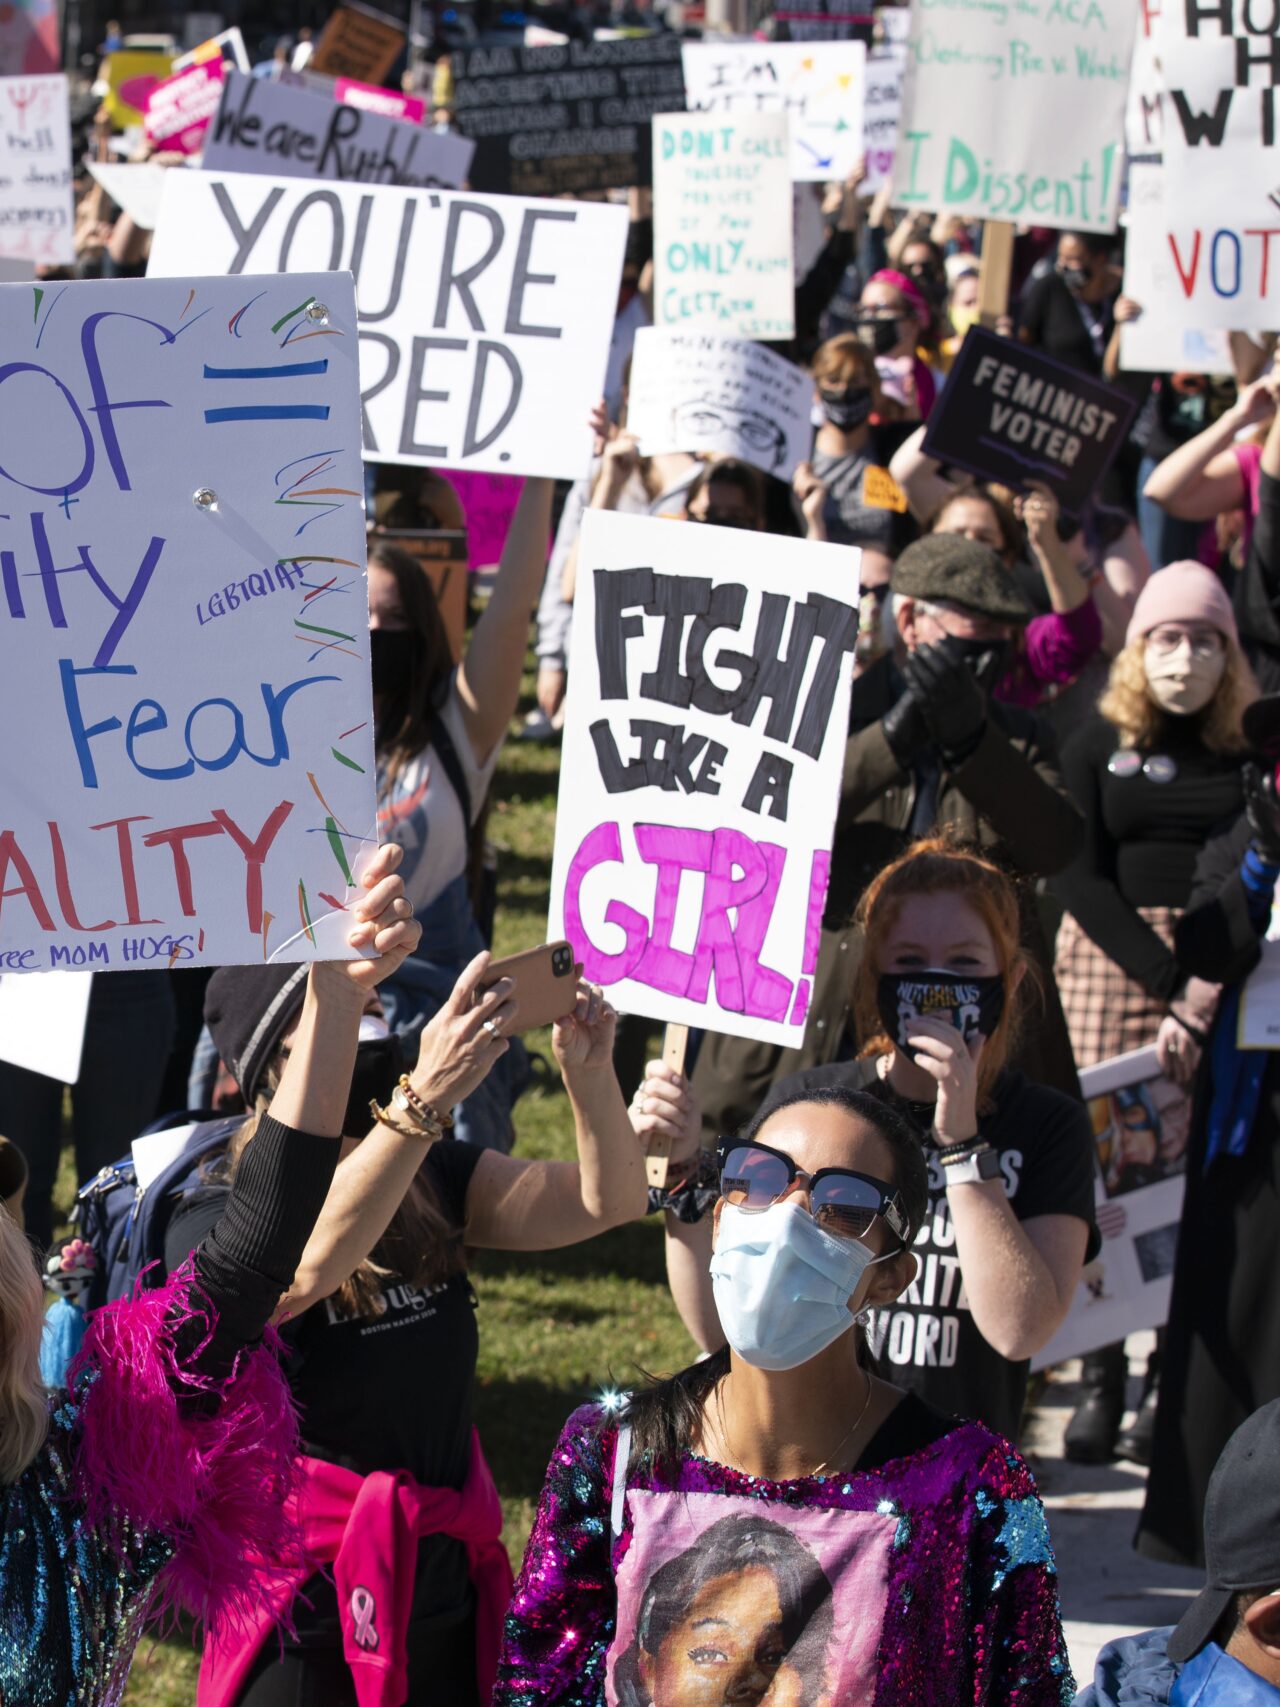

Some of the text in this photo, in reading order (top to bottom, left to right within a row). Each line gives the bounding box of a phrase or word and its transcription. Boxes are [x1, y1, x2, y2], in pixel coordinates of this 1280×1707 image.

[898, 131, 1117, 224] I Dissent!
[210, 183, 577, 338] YOU'RE
[667, 239, 745, 275] ONLY
[973, 354, 1117, 442] FEMINIST
[989, 400, 1082, 468] VOTER
[593, 567, 860, 761] FIGHT
[58, 658, 342, 789] Fear
[589, 719, 794, 822] LIKE A
[50, 942, 110, 966] MOM
[563, 821, 831, 1026] GIRL!
[360, 1322, 392, 1336] BOSTON
